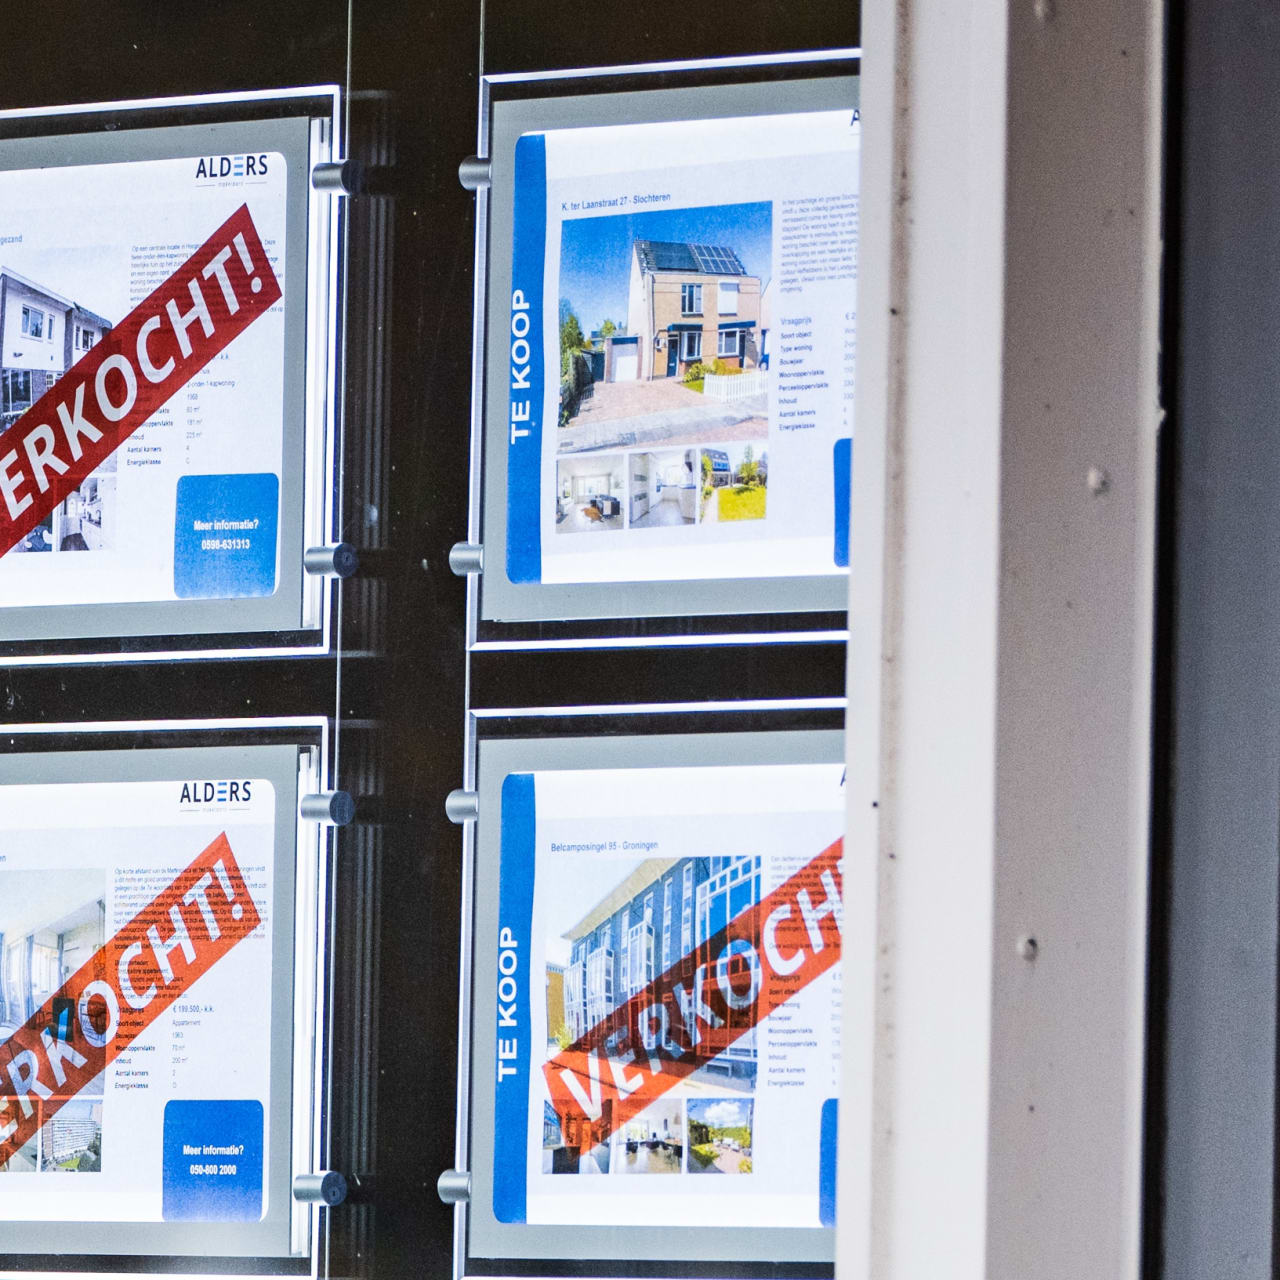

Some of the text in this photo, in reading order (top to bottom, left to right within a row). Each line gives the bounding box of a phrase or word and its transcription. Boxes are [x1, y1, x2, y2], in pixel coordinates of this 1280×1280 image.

[196, 154, 268, 178] ALDERS
[561, 193, 671, 211] K. ter Laanstraat 27 Slochteren
[511, 289, 531, 445] TE KOOP
[193, 518, 259, 531] Meer informatie?
[180, 781, 252, 803] ALDERS
[550, 840, 659, 853] Belcamposingel 95 Groningen
[560, 857, 843, 1122] VERKOCH
[498, 926, 518, 1083] TE KOOP
[183, 1144, 244, 1155] Meer informatie?
[219, 1164, 237, 1175] 2000
